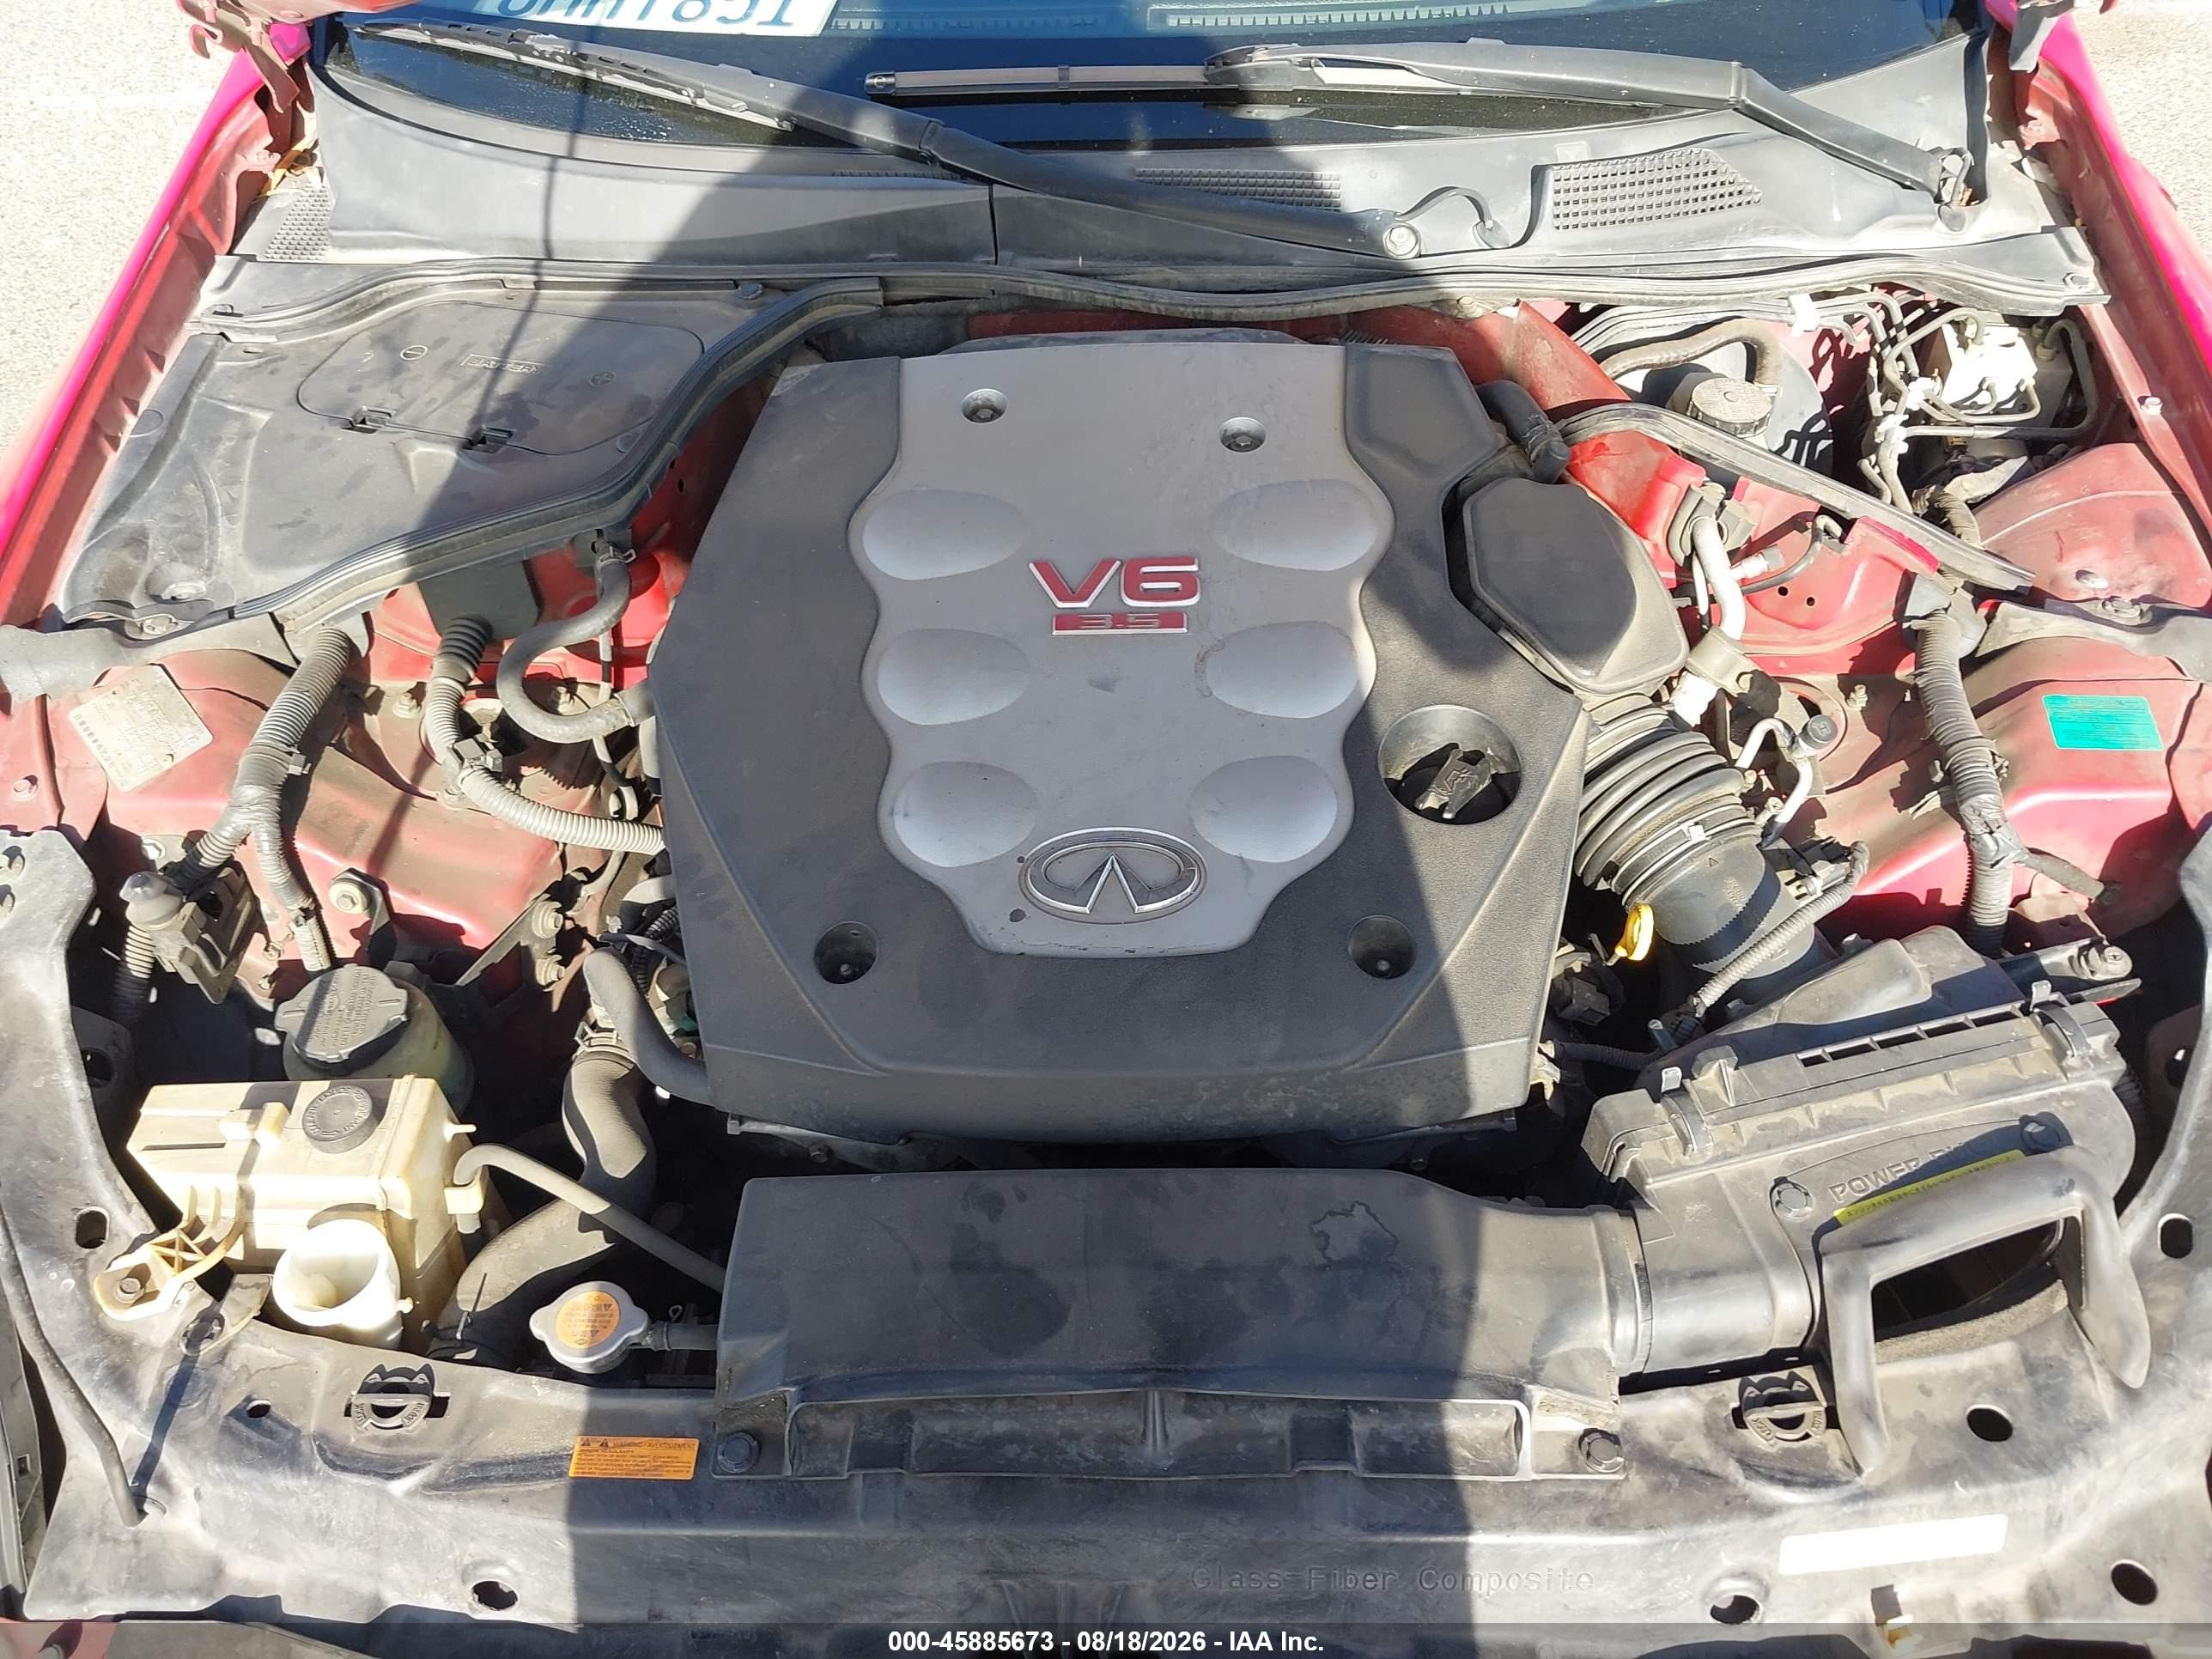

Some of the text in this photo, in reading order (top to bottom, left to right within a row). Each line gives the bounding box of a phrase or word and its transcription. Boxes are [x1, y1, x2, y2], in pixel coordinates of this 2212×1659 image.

[467, 357, 541, 374] BATTERY
[1028, 556, 1202, 609] V6
[1077, 611, 1162, 630] 3.5
[1827, 1157, 1922, 1204] POWER
[1191, 1565, 1595, 1597] Glass-Fiber Composite
